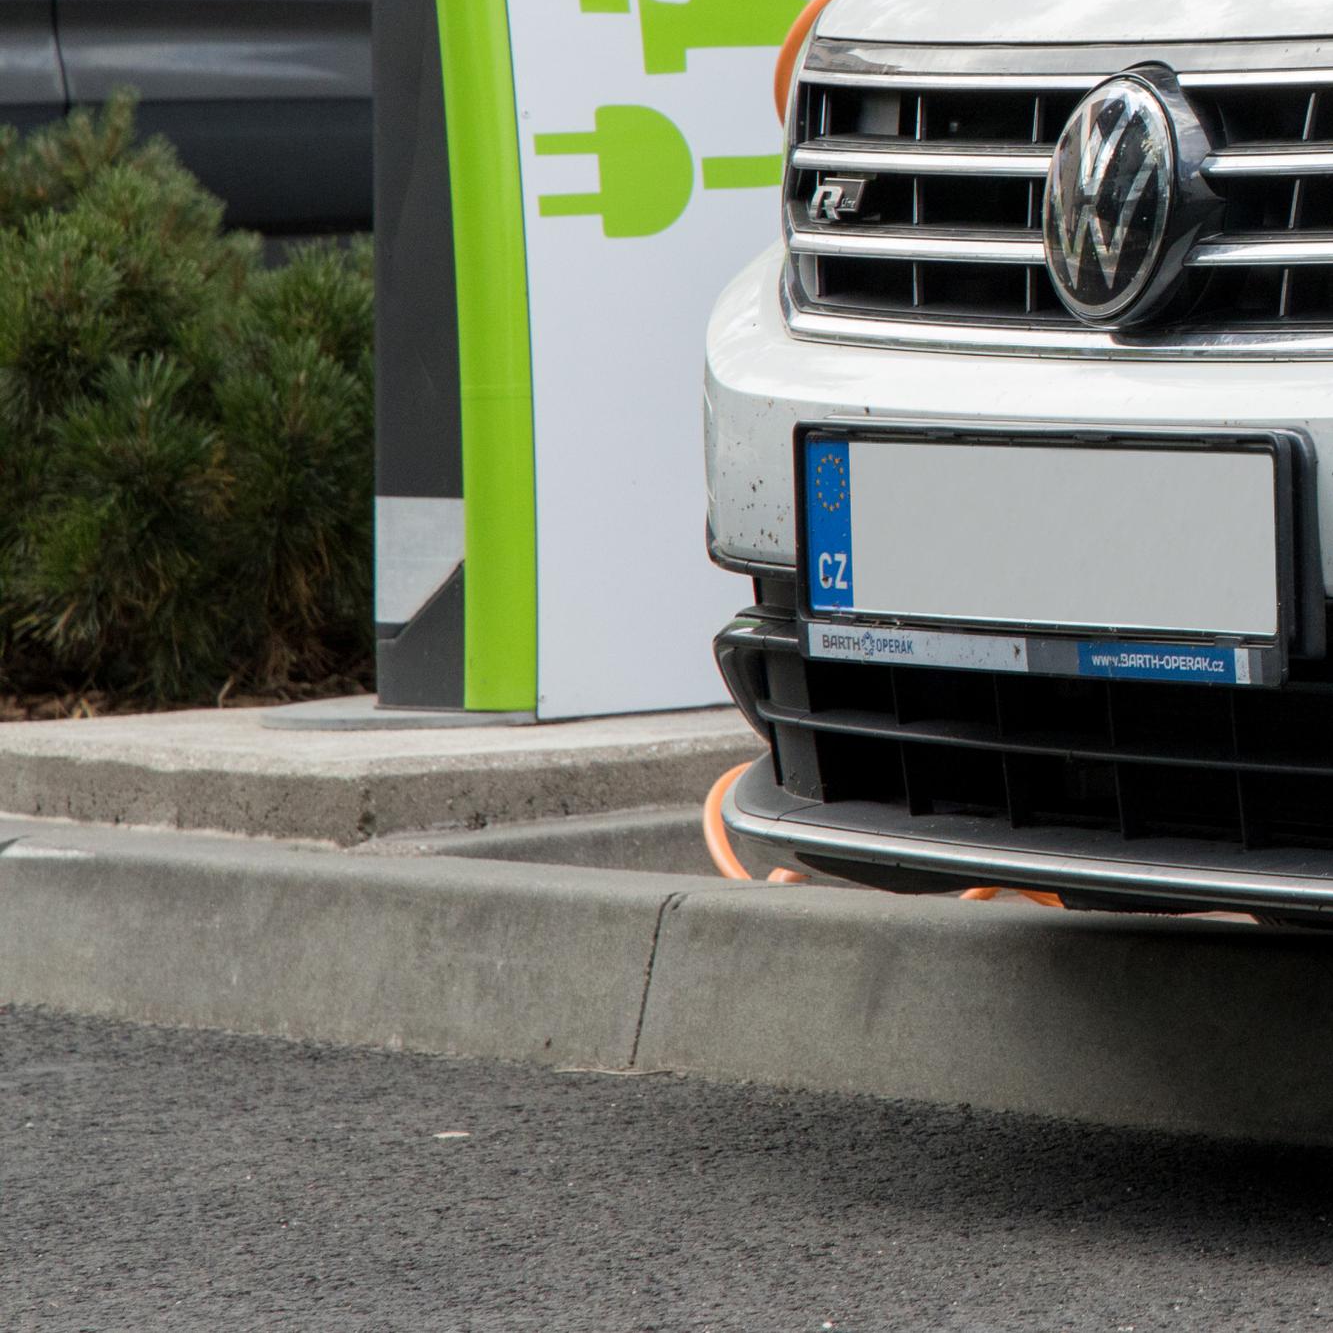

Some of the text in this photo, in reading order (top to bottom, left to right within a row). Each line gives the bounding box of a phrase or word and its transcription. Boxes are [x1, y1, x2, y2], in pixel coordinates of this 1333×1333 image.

[810, 185, 843, 220] R
[818, 552, 848, 589] CZ
[822, 634, 913, 655] BARTH OPERÁK
[1091, 653, 1225, 673] www.BARTH-OPERAK.cz
